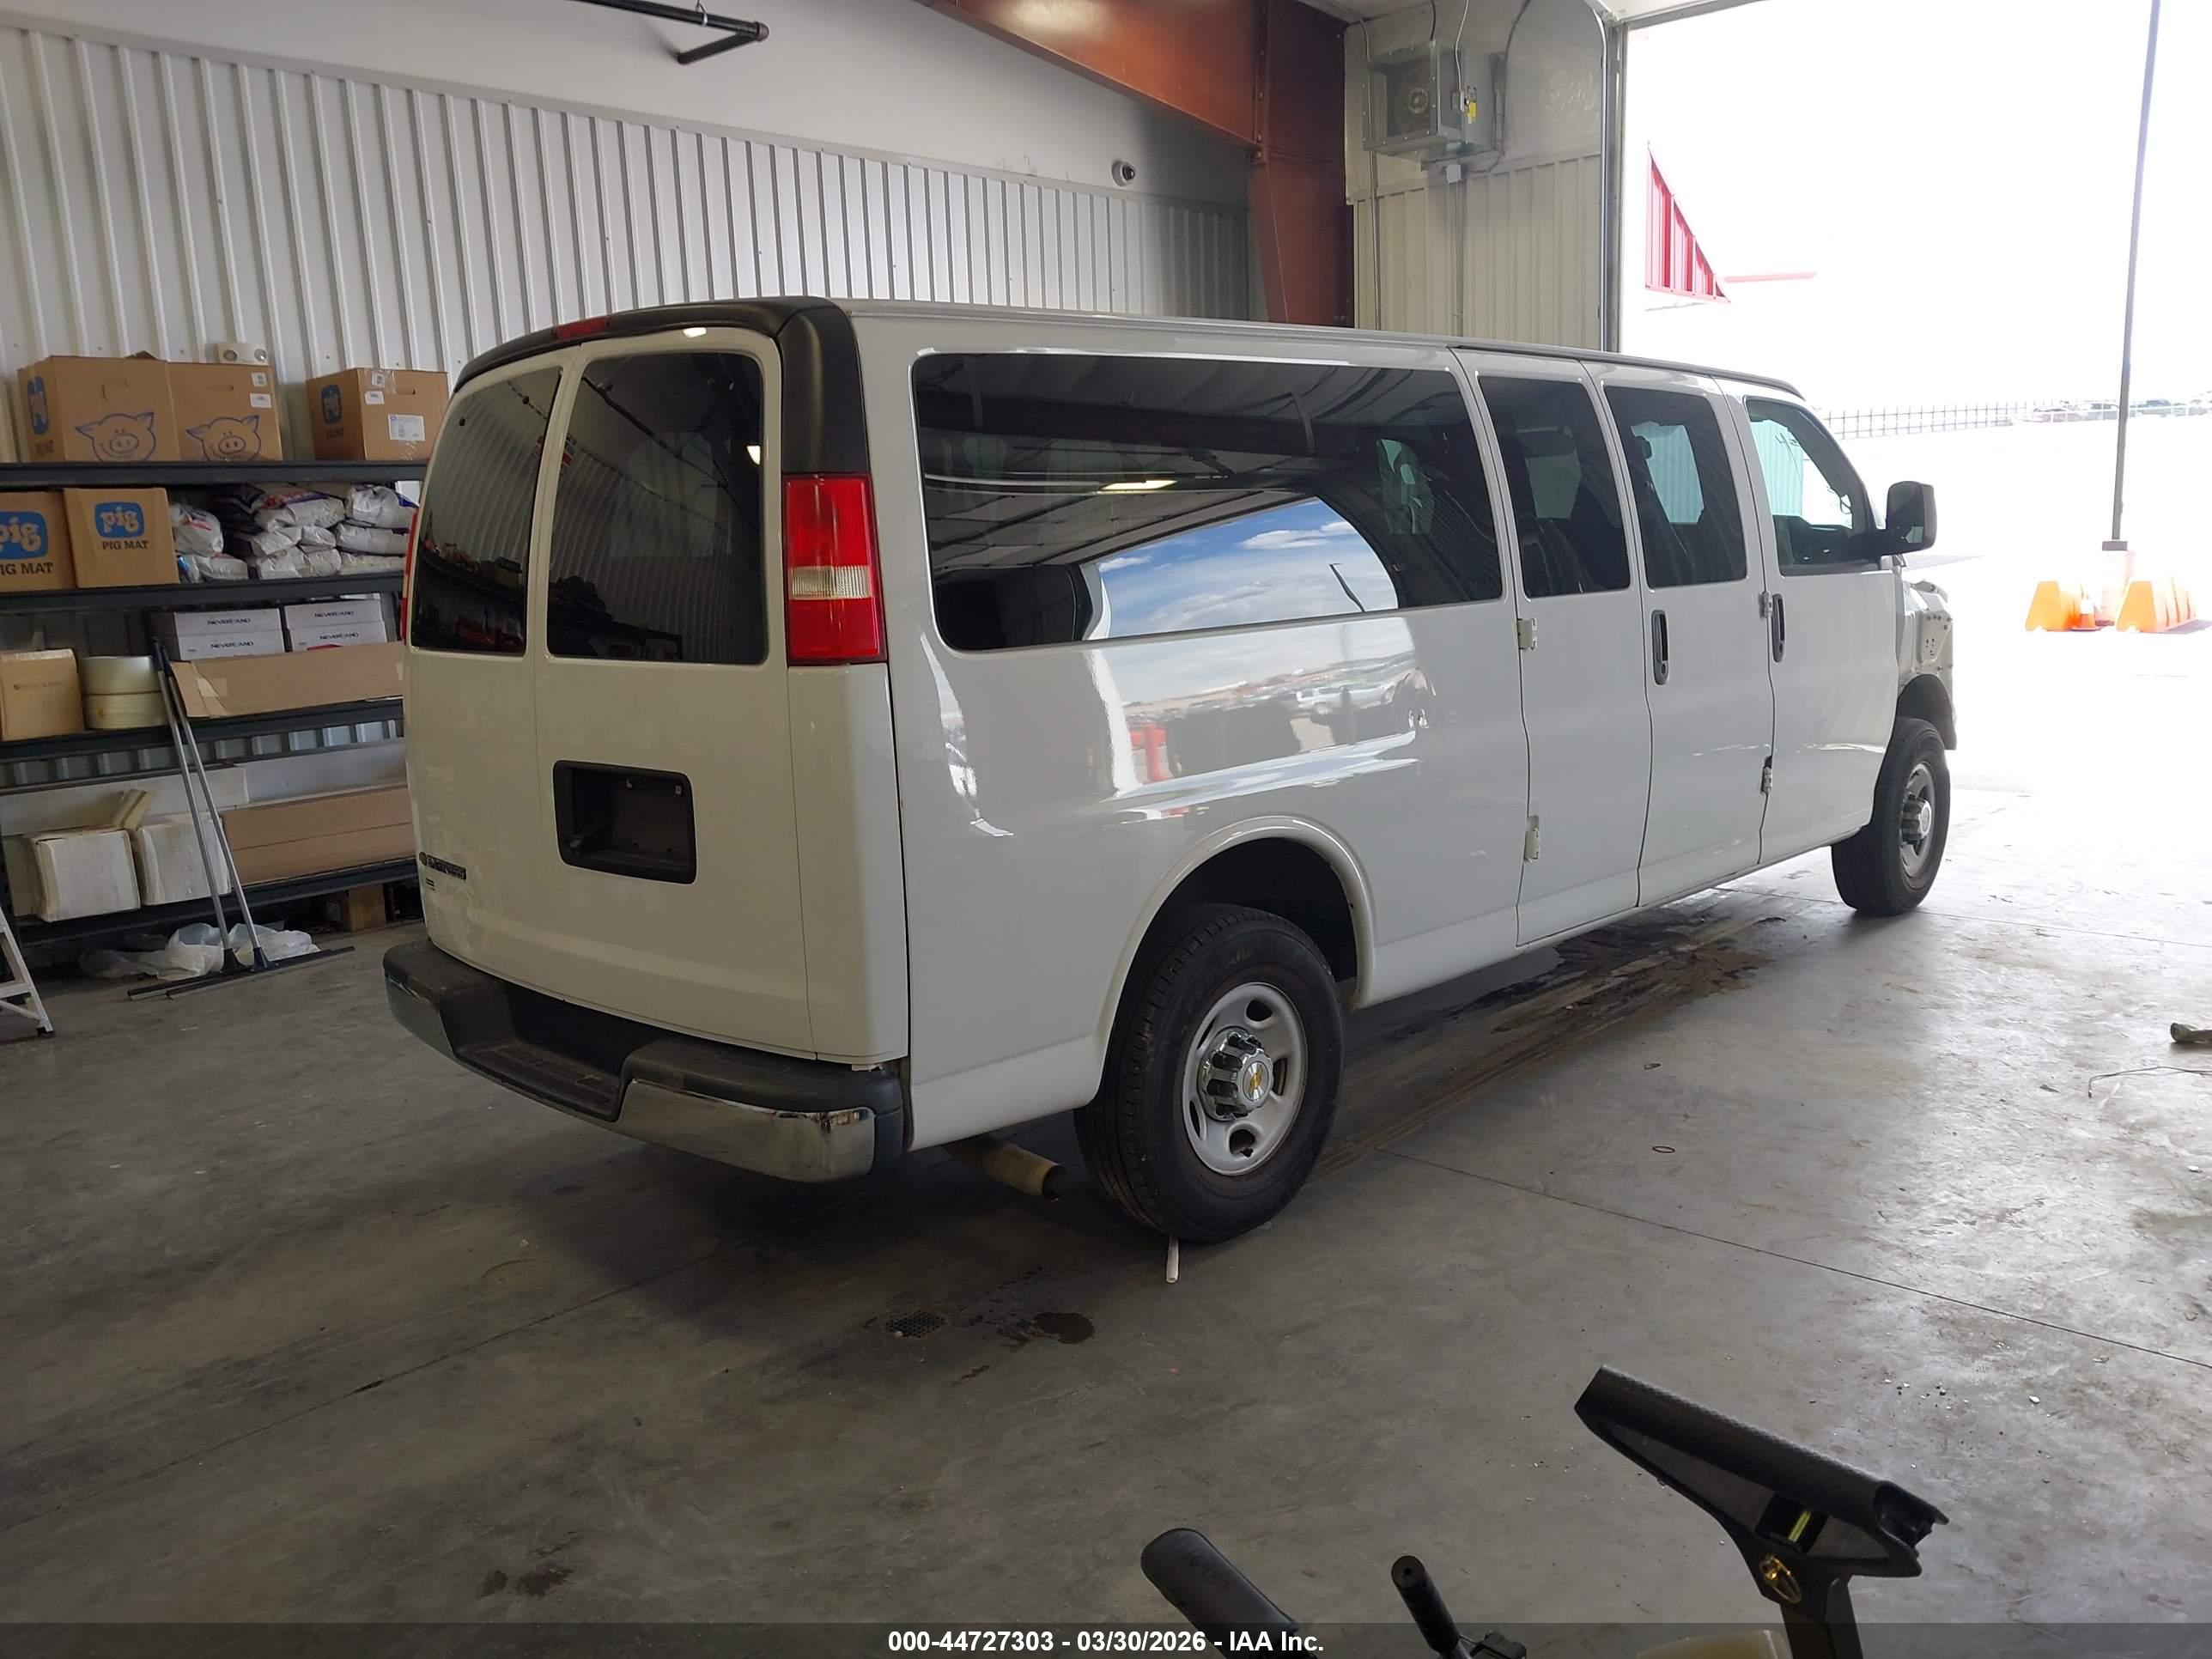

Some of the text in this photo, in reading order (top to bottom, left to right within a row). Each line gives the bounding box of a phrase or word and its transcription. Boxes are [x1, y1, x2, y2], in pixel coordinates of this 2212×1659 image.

[100, 506, 139, 534] pig
[102, 539, 149, 550] PIG MAT
[0, 562, 54, 575] IG MAT
